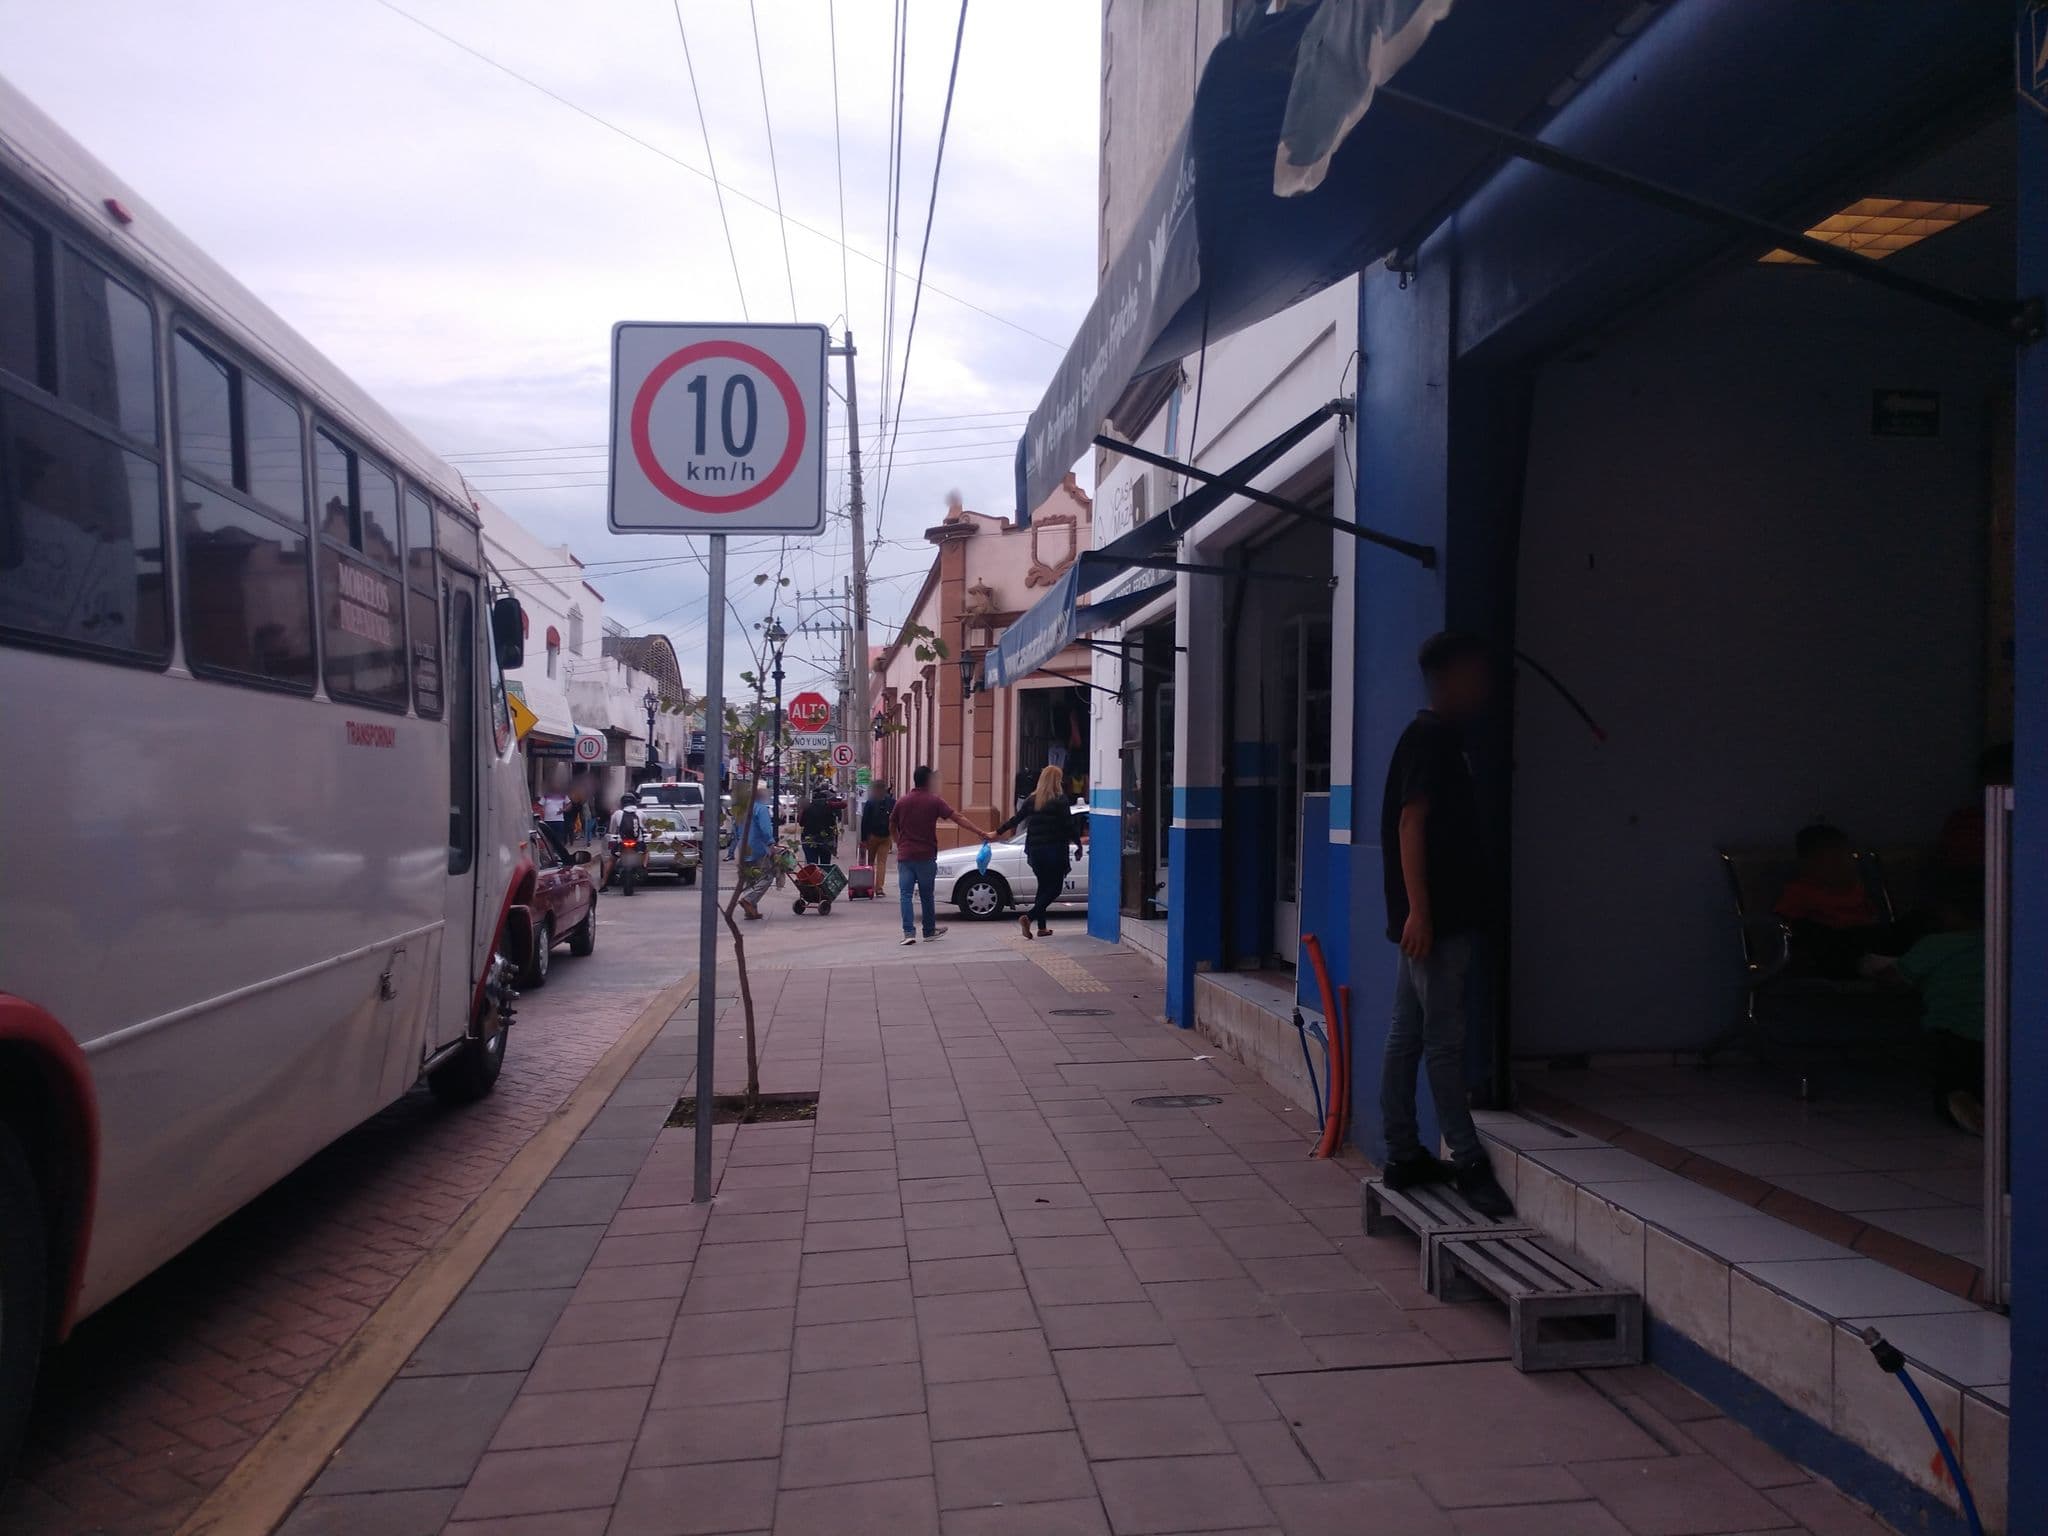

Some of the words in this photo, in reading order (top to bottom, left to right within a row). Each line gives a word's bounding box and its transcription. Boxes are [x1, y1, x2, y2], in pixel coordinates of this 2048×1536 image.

[687, 374, 757, 458] 10
[687, 461, 755, 481] km/h
[338, 562, 389, 613] MORELOS
[791, 704, 827, 719] ALTO
[583, 741, 594, 753] 10
[806, 738, 811, 746] Y
[812, 738, 827, 746] UNO
[839, 748, 848, 761] E
[1064, 880, 1075, 890] XI
